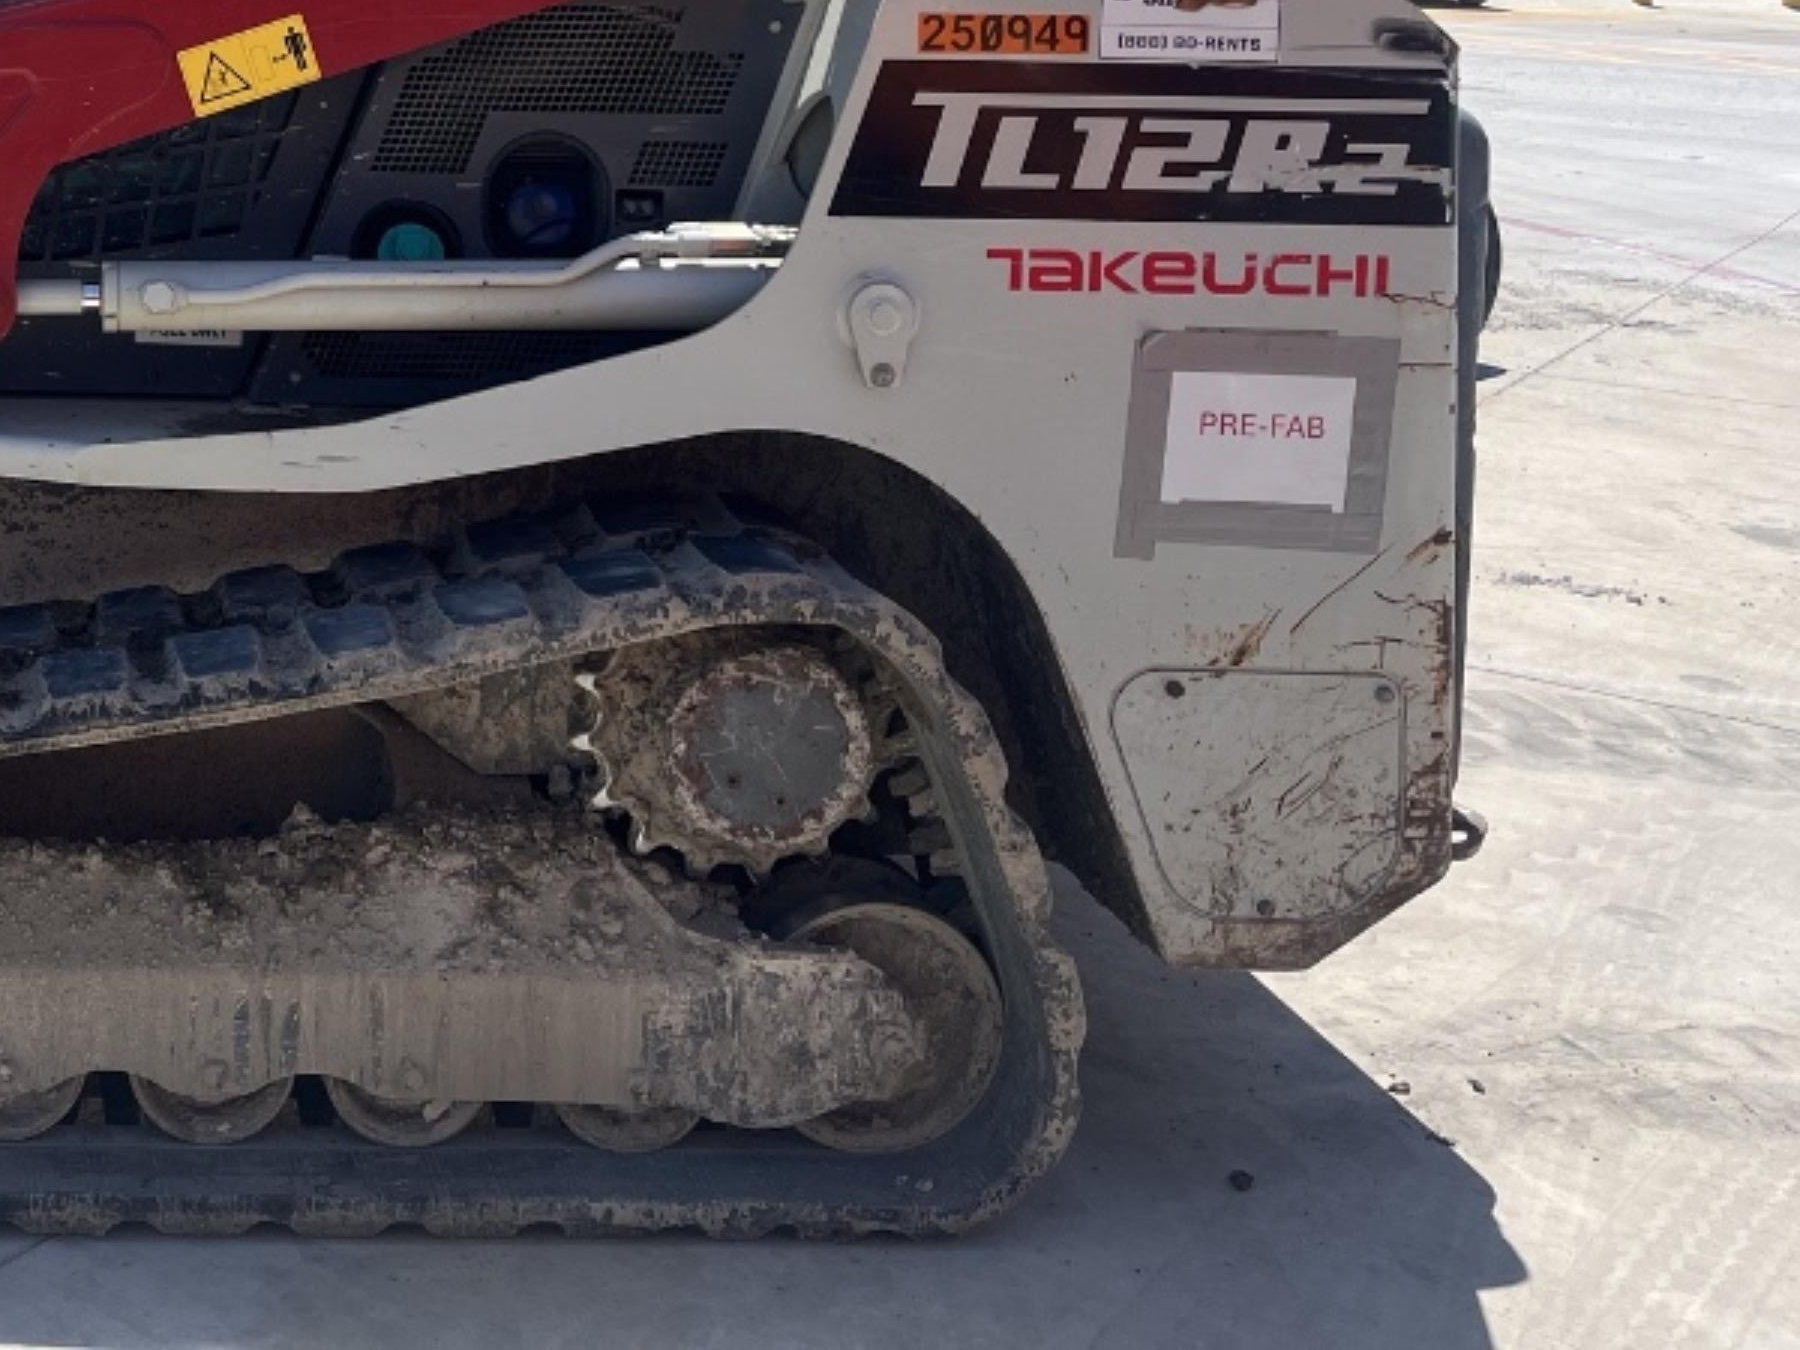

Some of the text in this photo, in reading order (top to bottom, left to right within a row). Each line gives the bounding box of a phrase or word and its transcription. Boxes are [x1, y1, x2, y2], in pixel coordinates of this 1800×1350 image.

[920, 14, 1090, 52] 250949
[986, 248, 1390, 298] TAKEUCHI
[1199, 410, 1325, 439] PRE-FAB
